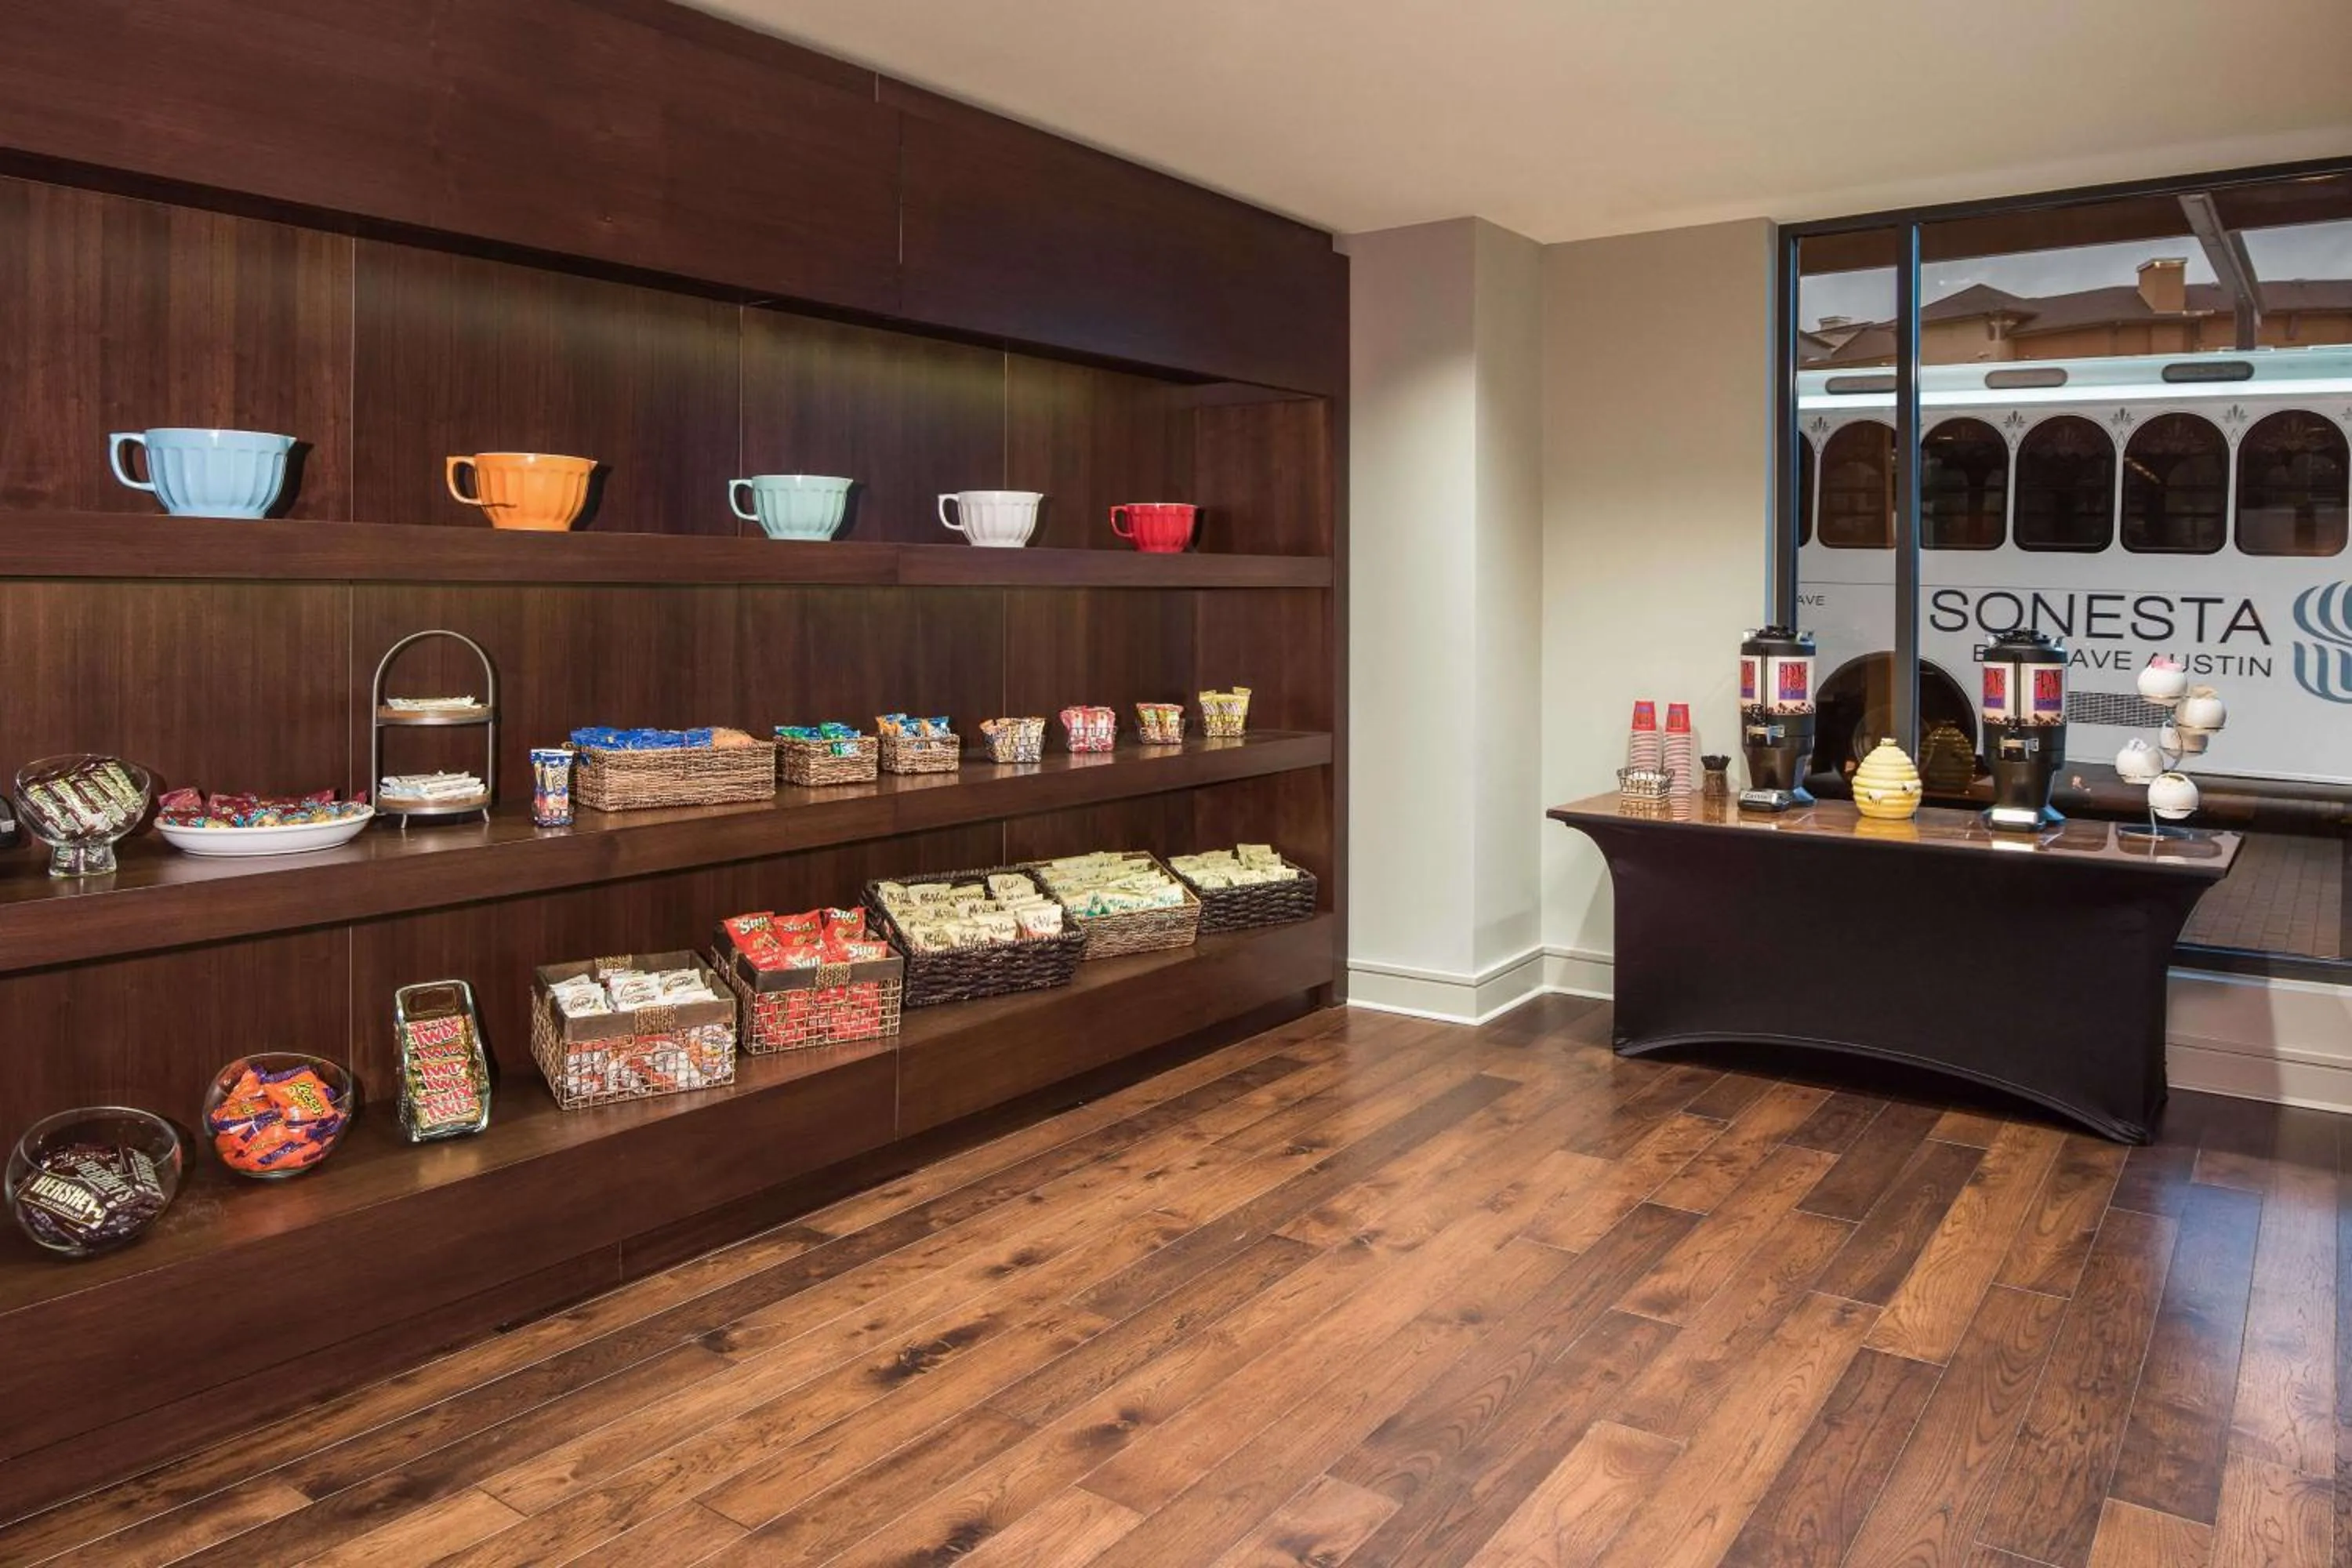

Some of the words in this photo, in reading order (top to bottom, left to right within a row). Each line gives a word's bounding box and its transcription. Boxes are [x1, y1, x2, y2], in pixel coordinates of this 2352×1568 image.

[1796, 593, 1826, 606] AVE
[1929, 589, 2271, 645] SONESTA
[2068, 648, 2132, 670] AVE
